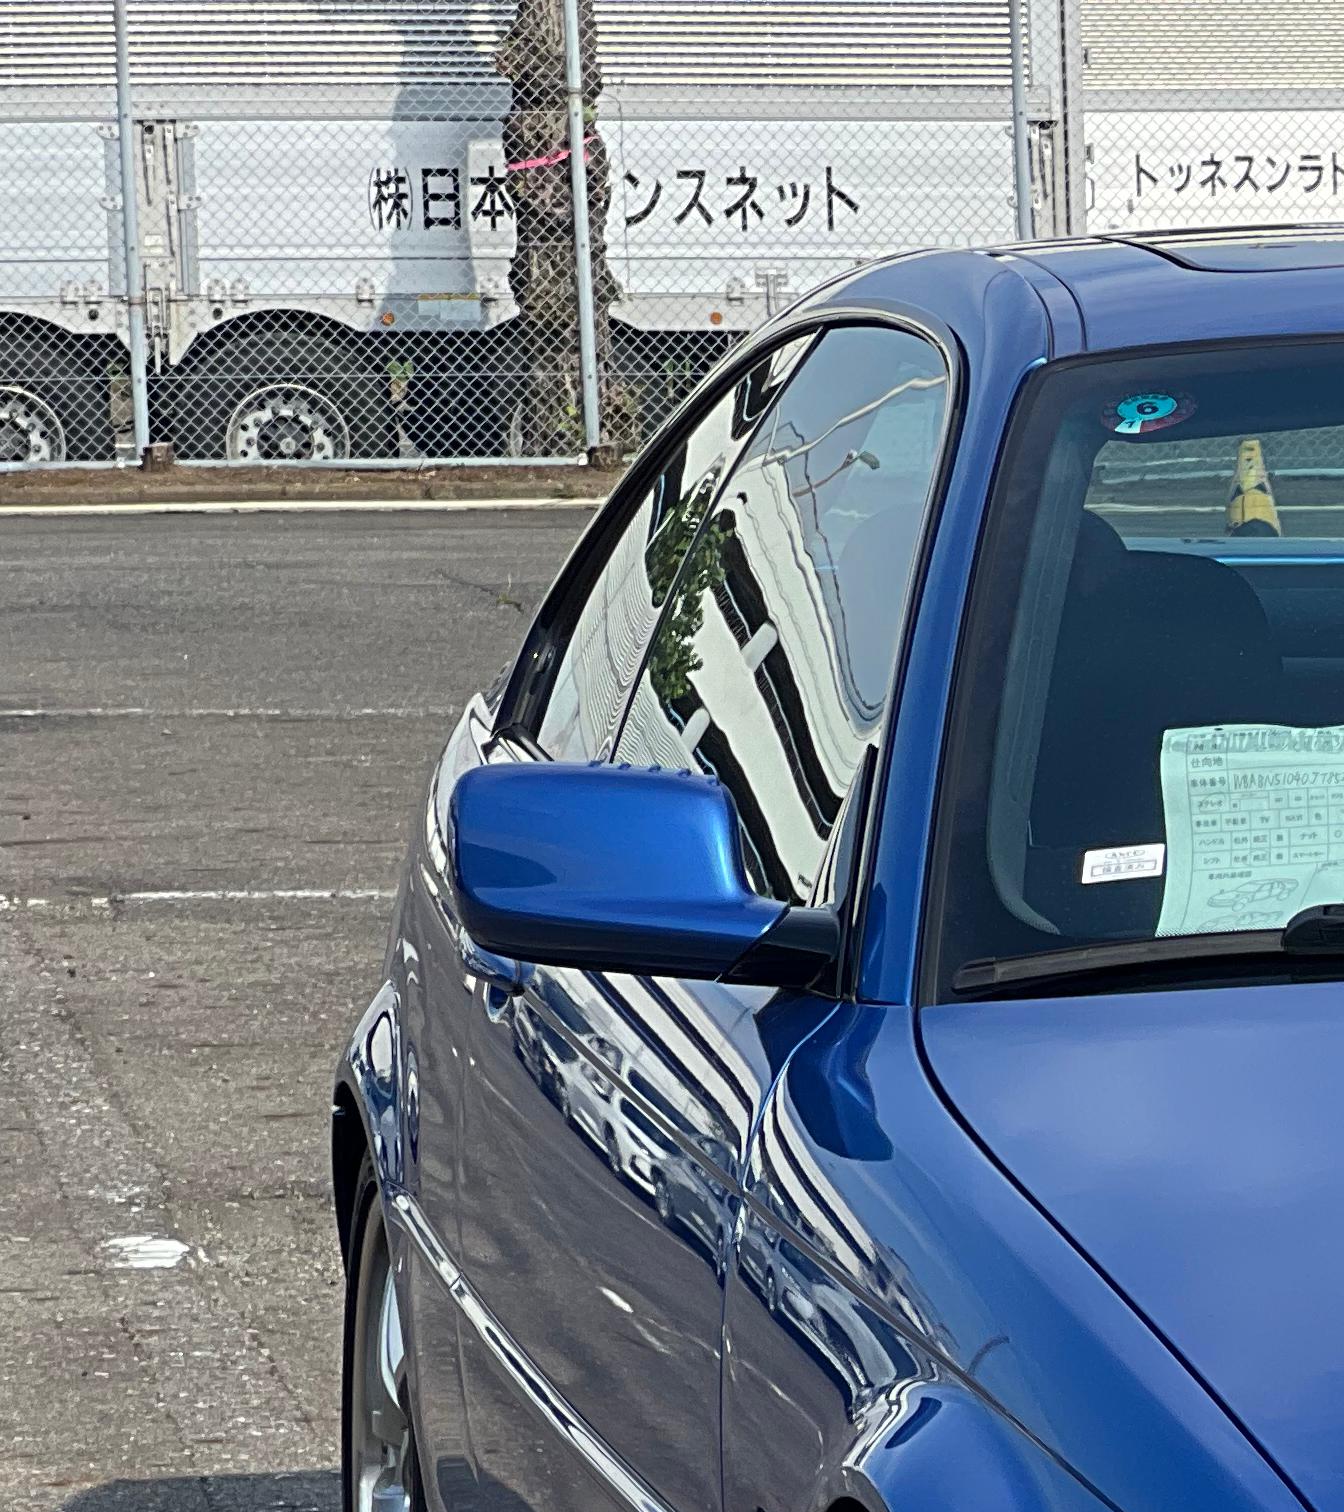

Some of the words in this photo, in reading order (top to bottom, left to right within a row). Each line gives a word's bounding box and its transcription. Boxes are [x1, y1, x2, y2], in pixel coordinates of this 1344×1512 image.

[368, 165, 860, 232] (株)日本ンスネット
